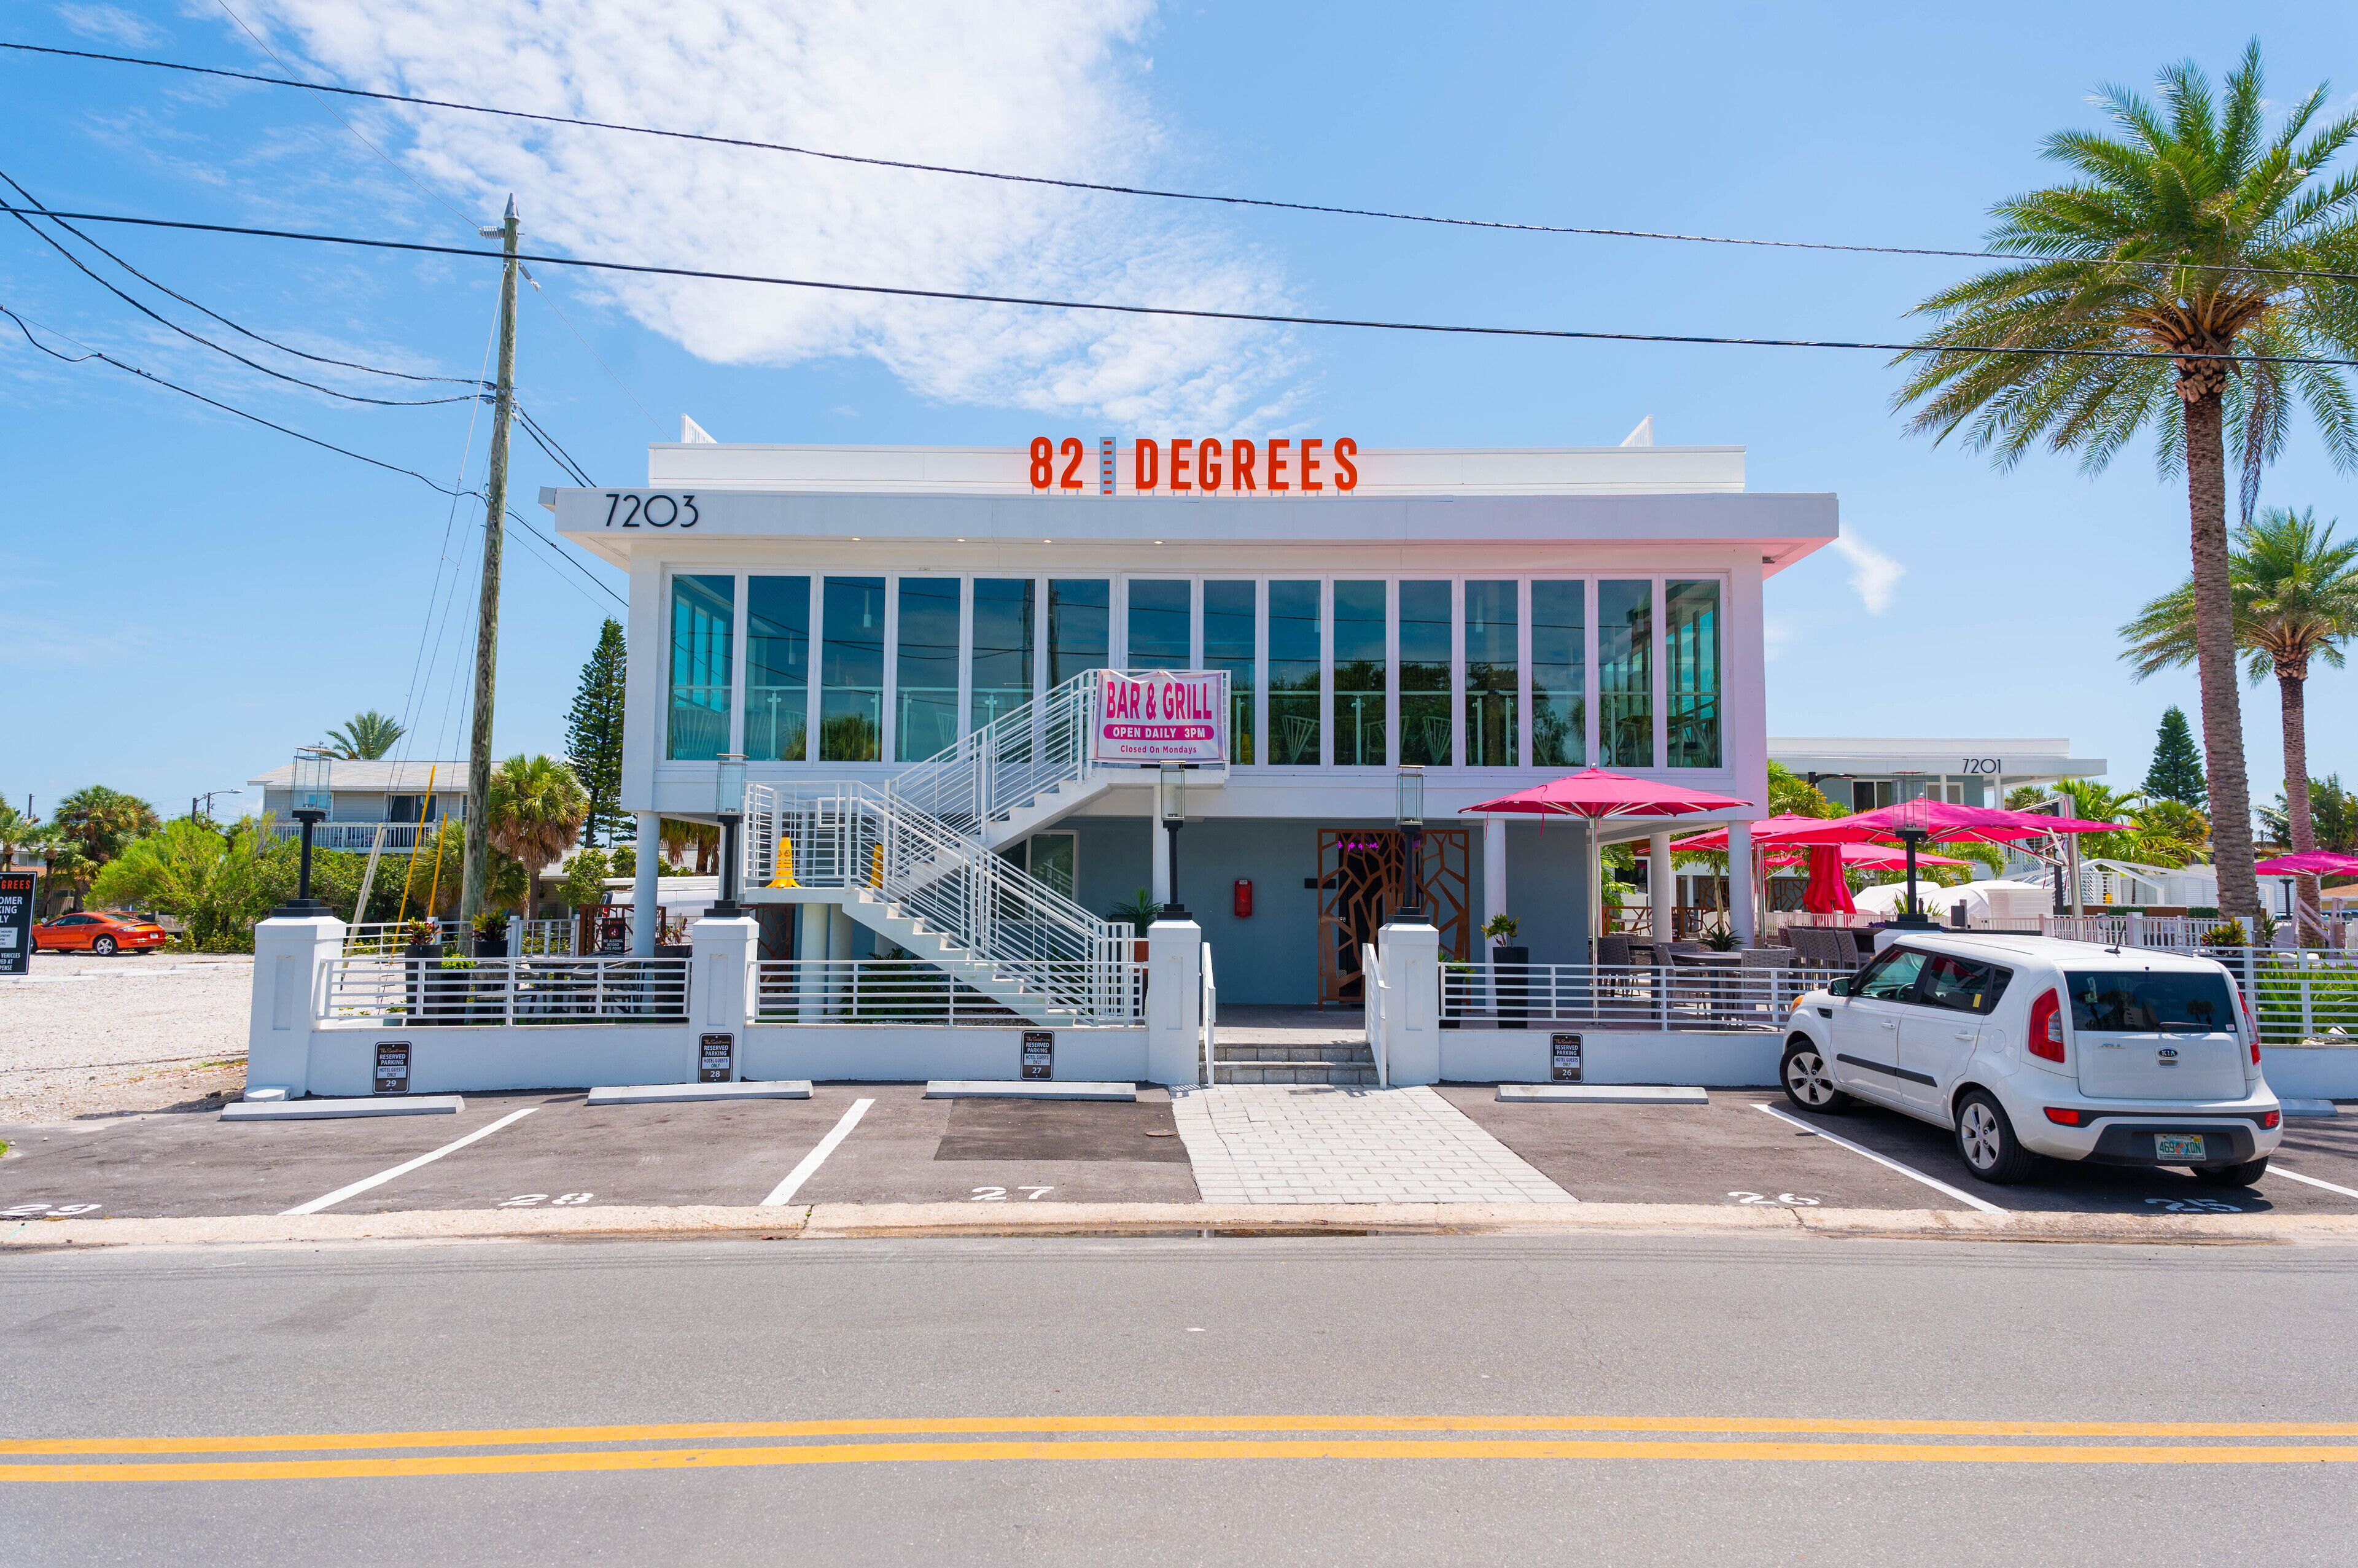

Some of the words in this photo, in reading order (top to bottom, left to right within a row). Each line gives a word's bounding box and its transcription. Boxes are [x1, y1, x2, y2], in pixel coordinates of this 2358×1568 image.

[1030, 437, 1083, 489] 82
[1135, 437, 1358, 491] DEGREES
[605, 494, 699, 527] 7203
[1106, 681, 1140, 720] BAR
[1146, 682, 1157, 721] &
[1162, 682, 1212, 720] GRILL
[1113, 726, 1141, 737] OPEN
[1145, 727, 1177, 738] DAILY
[1184, 728, 1205, 738] 3PM
[1121, 745, 1146, 753] Closed
[1163, 745, 1197, 755] Mondays
[1963, 758, 2001, 774] 7201
[0, 880, 31, 890] GREES
[0, 906, 17, 914] ING
[2159, 1141, 2175, 1154] 469
[497, 1193, 594, 1206] 28
[970, 1186, 1054, 1201] 27
[1727, 1191, 1820, 1205] 26
[0, 1204, 102, 1216] 29
[2144, 1198, 2243, 1212] 25
